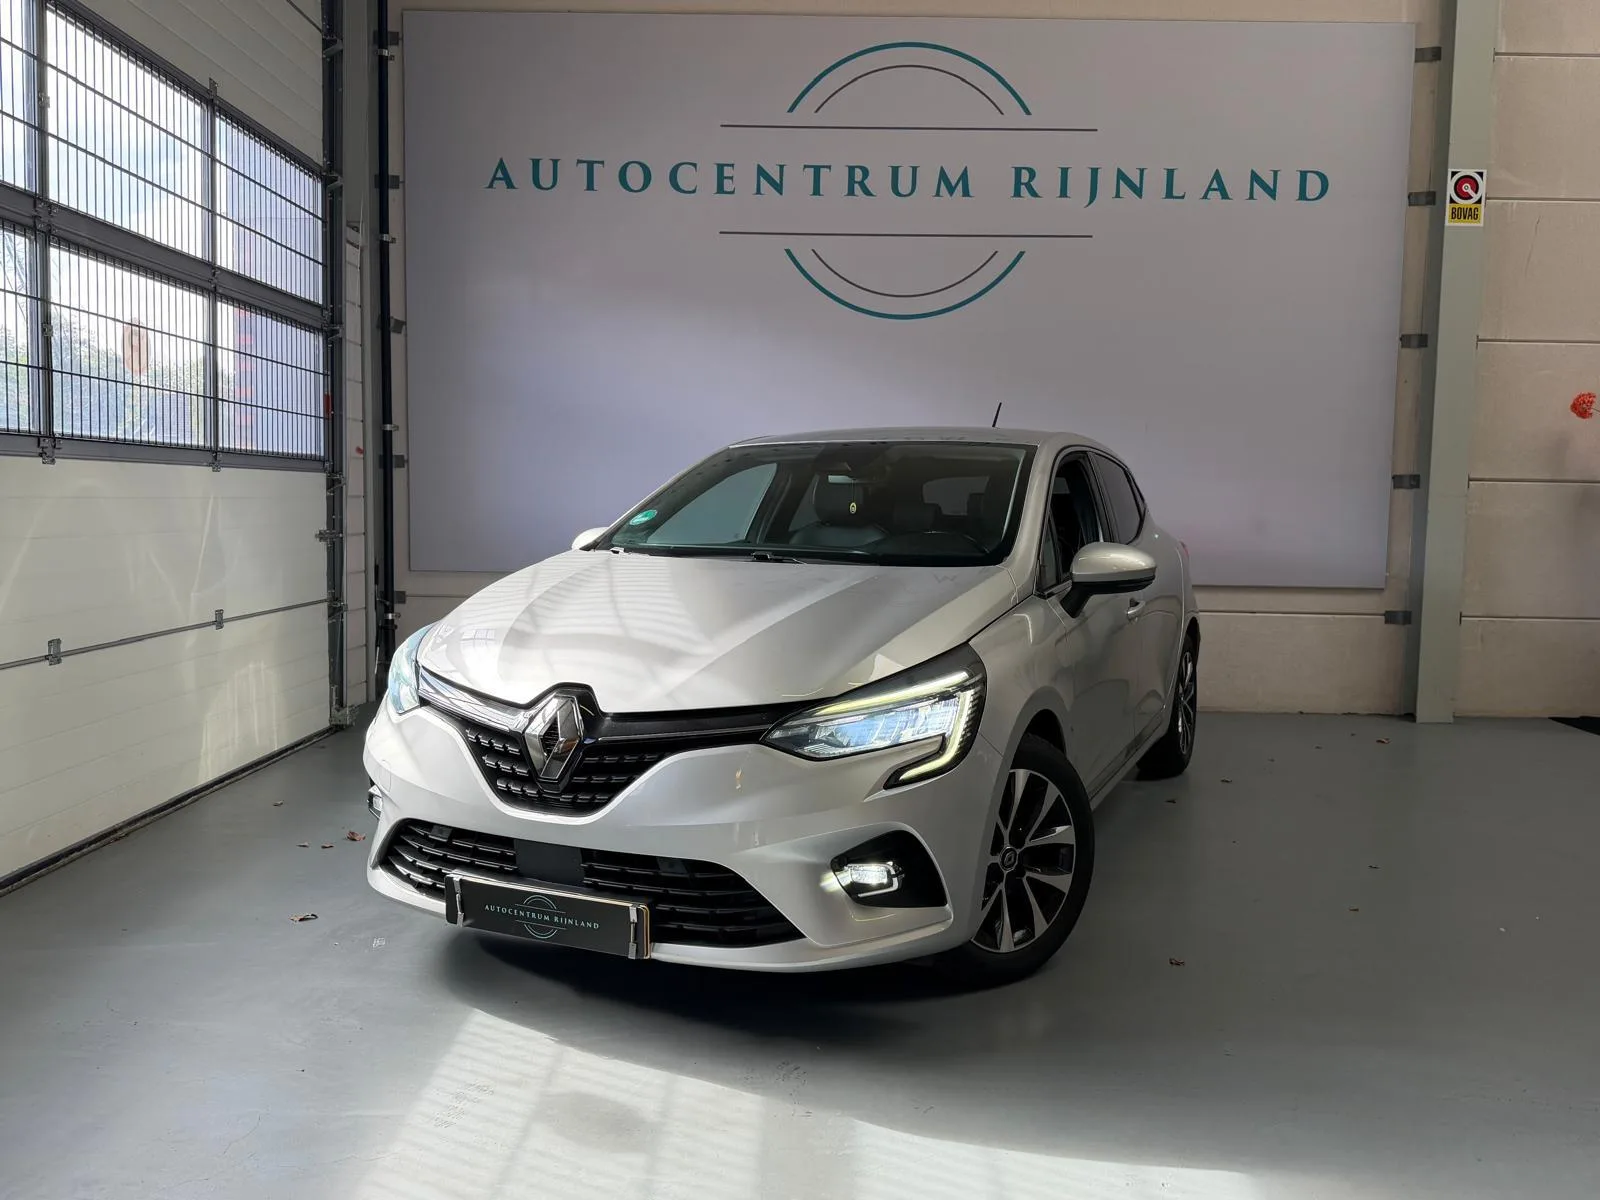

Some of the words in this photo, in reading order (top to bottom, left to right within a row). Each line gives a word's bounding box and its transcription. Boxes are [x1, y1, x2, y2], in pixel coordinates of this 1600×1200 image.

[484, 157, 974, 198] AUTOCENTRUM
[1011, 166, 1330, 208] RIJNLAND
[1451, 207, 1479, 220] BOVAG
[484, 904, 550, 921] AUTOCENTRUM
[553, 915, 599, 929] RIJNLAND
